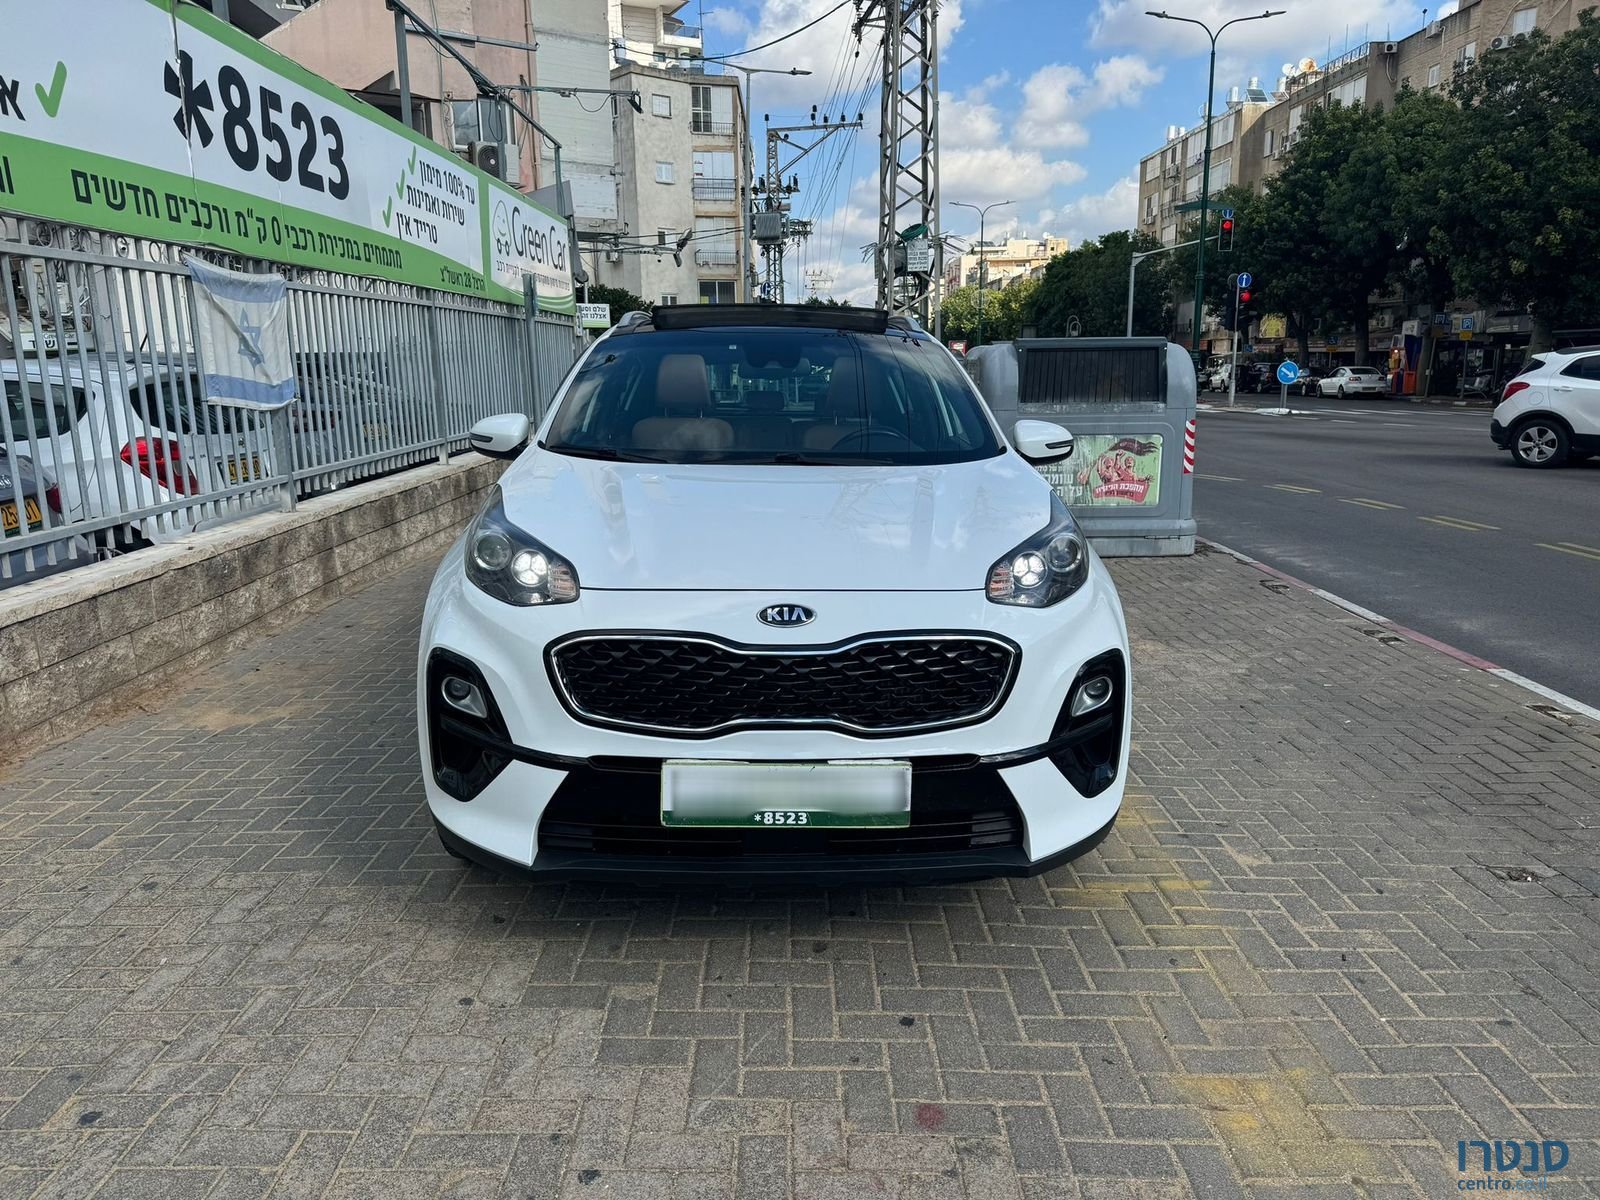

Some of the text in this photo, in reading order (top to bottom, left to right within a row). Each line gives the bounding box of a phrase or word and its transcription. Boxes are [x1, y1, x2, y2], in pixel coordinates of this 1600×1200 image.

[0, 73, 26, 122] א
[71, 168, 160, 219] חדשים
[419, 160, 475, 205] עד 100% מימון
[165, 192, 231, 234] ורכבים
[406, 184, 465, 226] שירות ואמינות
[271, 215, 282, 246] 0
[284, 224, 317, 253] רכבי
[396, 212, 438, 244] טרייד אין
[512, 206, 567, 272] Green Car
[318, 231, 362, 261] במכירת
[362, 242, 403, 270] מתמחים
[592, 305, 607, 313] שלם
[766, 606, 807, 621] KIA
